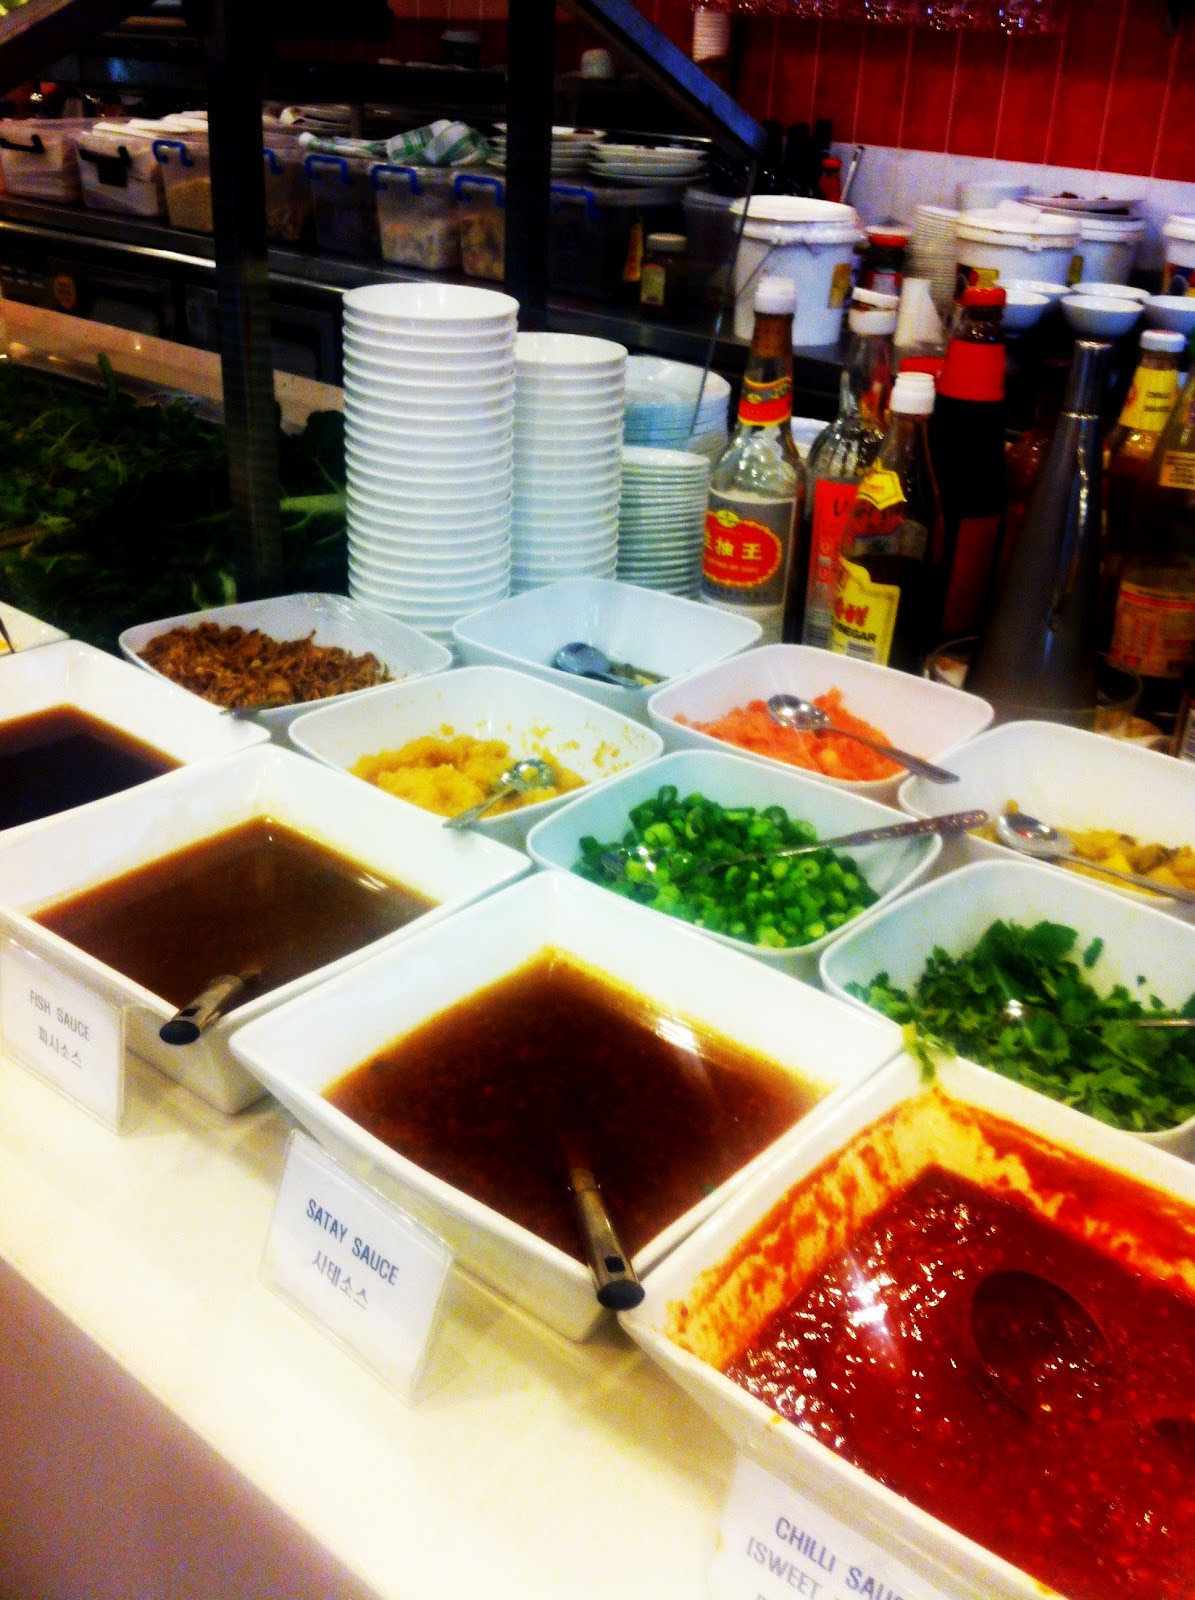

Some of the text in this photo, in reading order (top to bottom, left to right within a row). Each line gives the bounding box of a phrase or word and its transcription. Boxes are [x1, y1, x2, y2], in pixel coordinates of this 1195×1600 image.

[30, 990, 90, 1041] FISH SAUCE
[39, 1026, 83, 1068] 피시소스
[306, 1198, 399, 1286] SATAY SAUCE
[312, 1250, 368, 1310] 사테소스
[775, 1516, 905, 1600] CHILLI SAU
